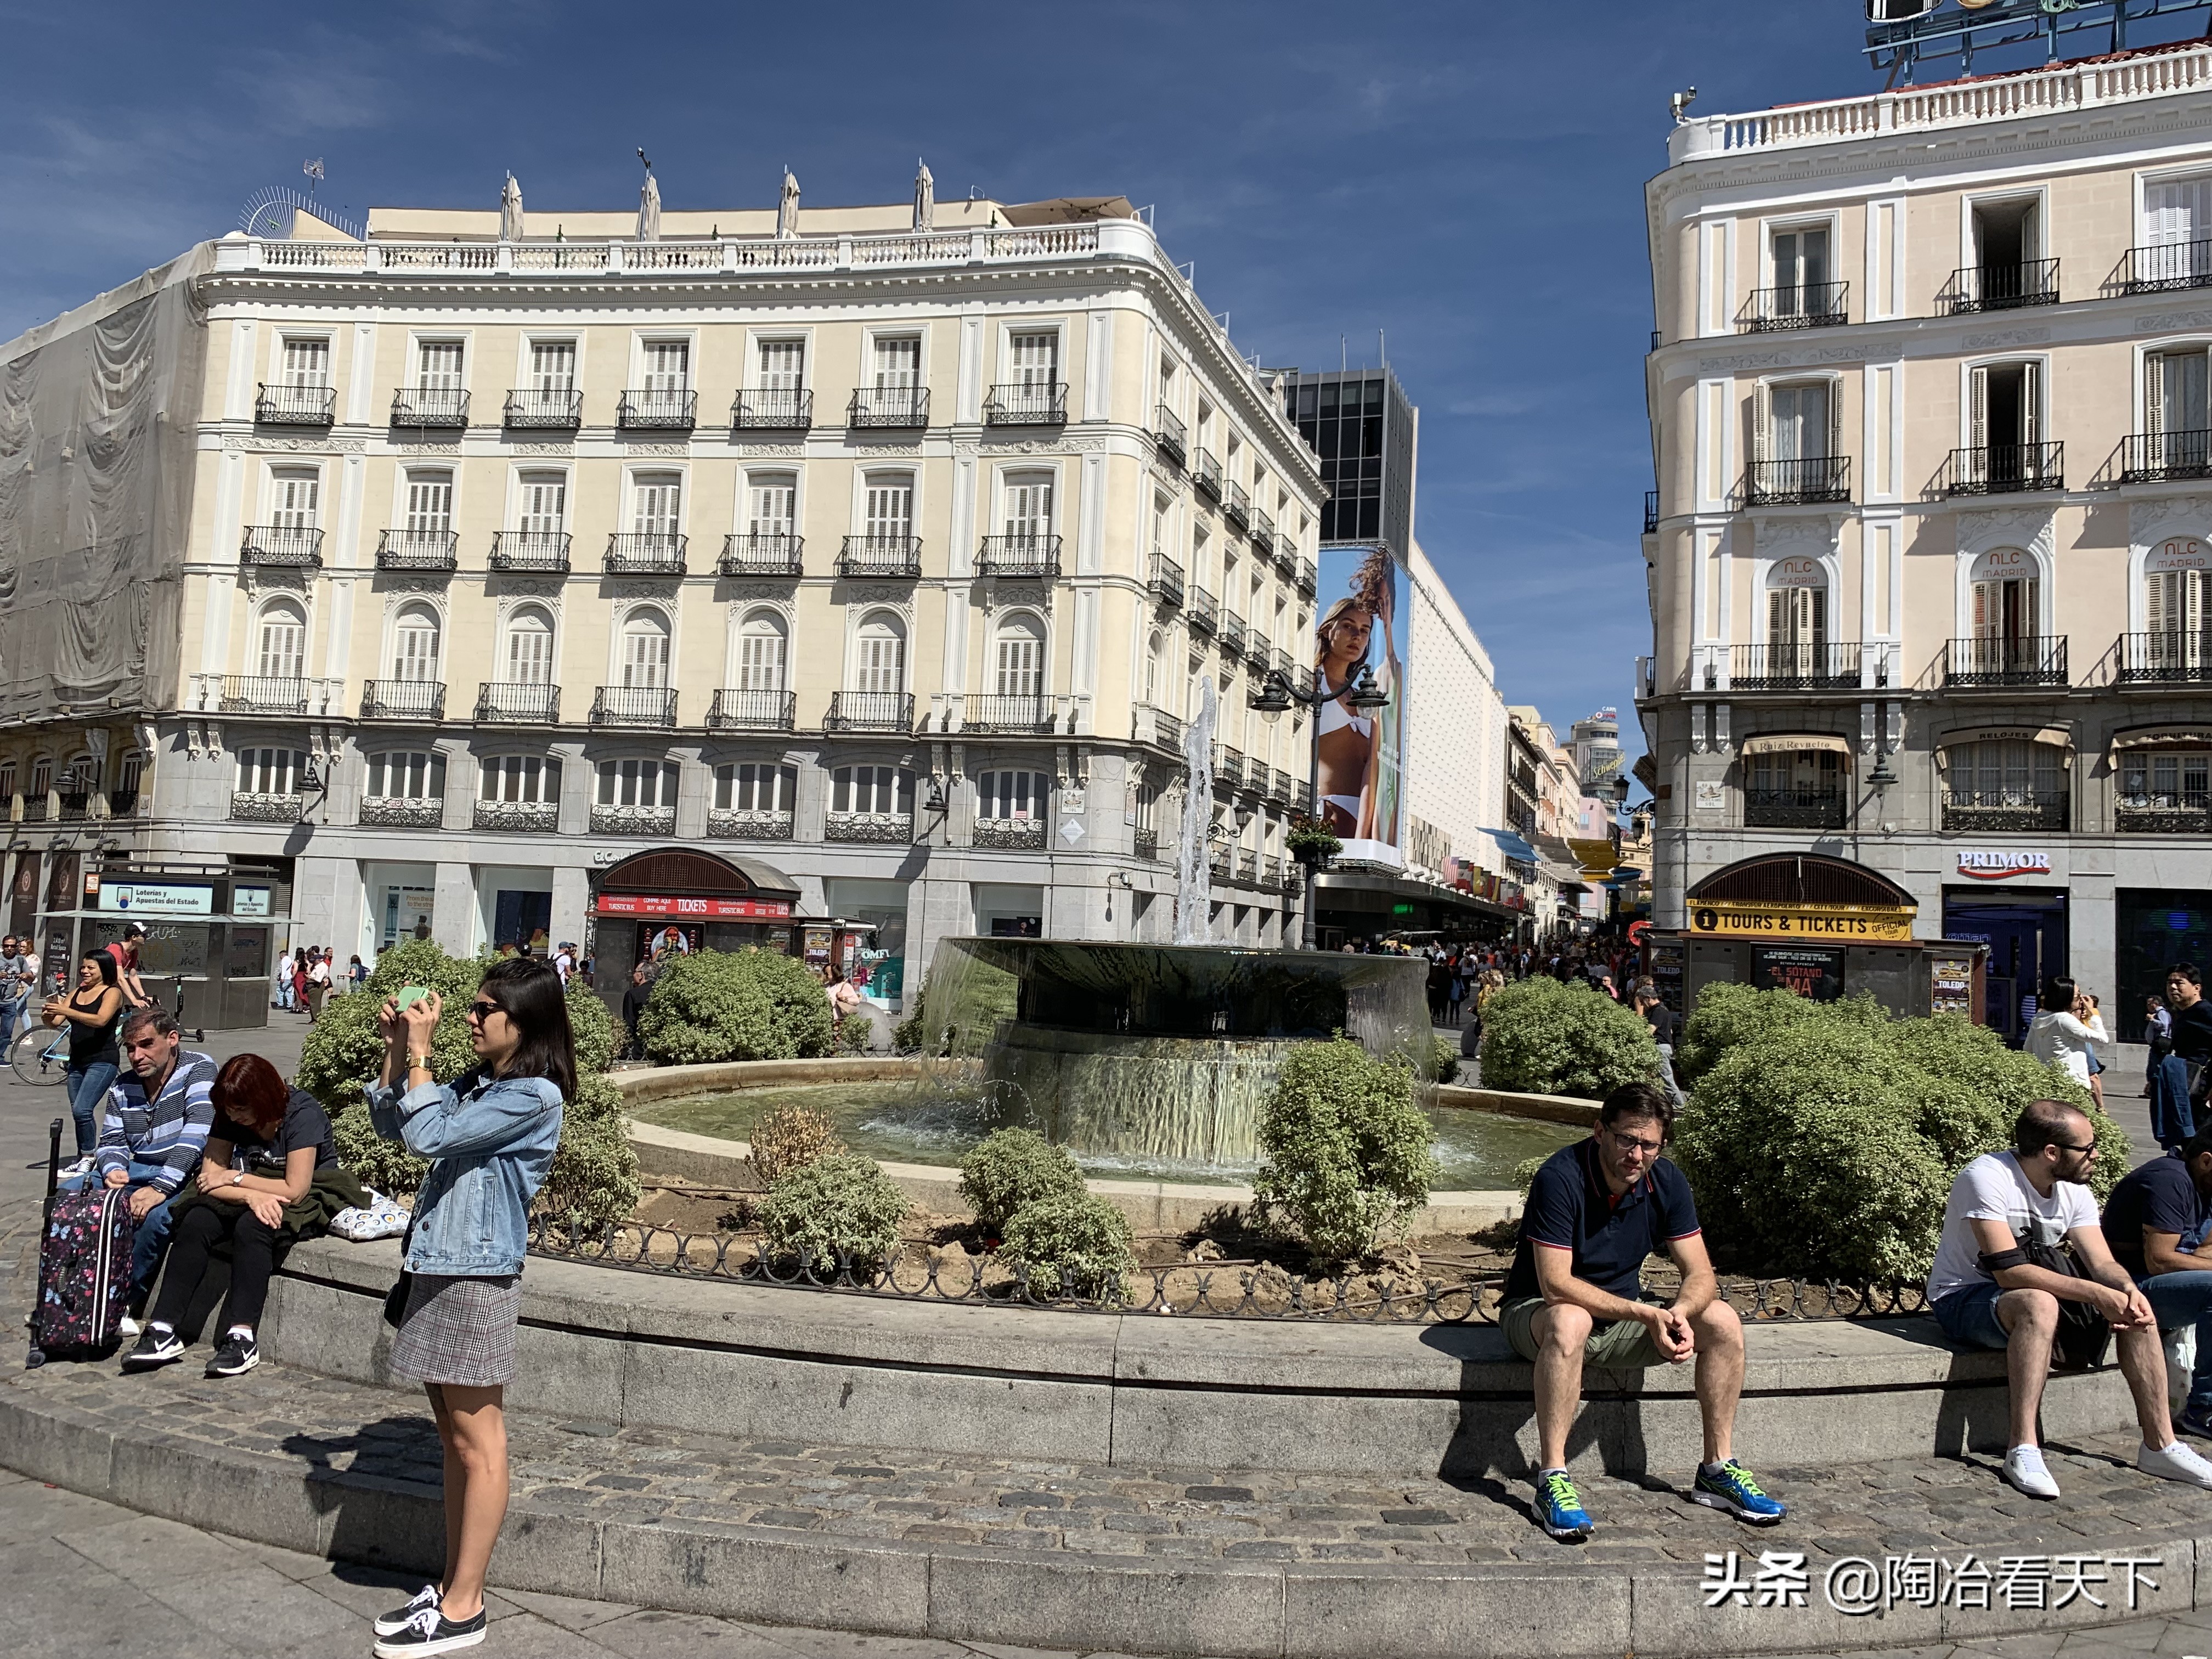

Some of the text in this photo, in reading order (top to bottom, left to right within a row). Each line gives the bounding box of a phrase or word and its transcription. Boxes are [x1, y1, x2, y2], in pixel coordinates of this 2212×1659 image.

[2157, 558, 2205, 568] MADRID
[1982, 568, 2027, 578] MADRID
[1778, 576, 1818, 585] MADRID
[1760, 742, 1782, 751] Ruiz
[594, 850, 605, 861] El
[1959, 851, 2051, 868] PRIMOR
[677, 899, 707, 912] TICKETS
[1722, 913, 1773, 929] TOURS
[1779, 915, 1791, 930] &
[1797, 916, 1867, 933] TICKETS
[1872, 919, 1908, 933] OFFICIAL
[1771, 966, 1822, 978] EL SÓTANO
[1785, 977, 1813, 997] MA
[1938, 980, 1965, 989] TOLEDO
